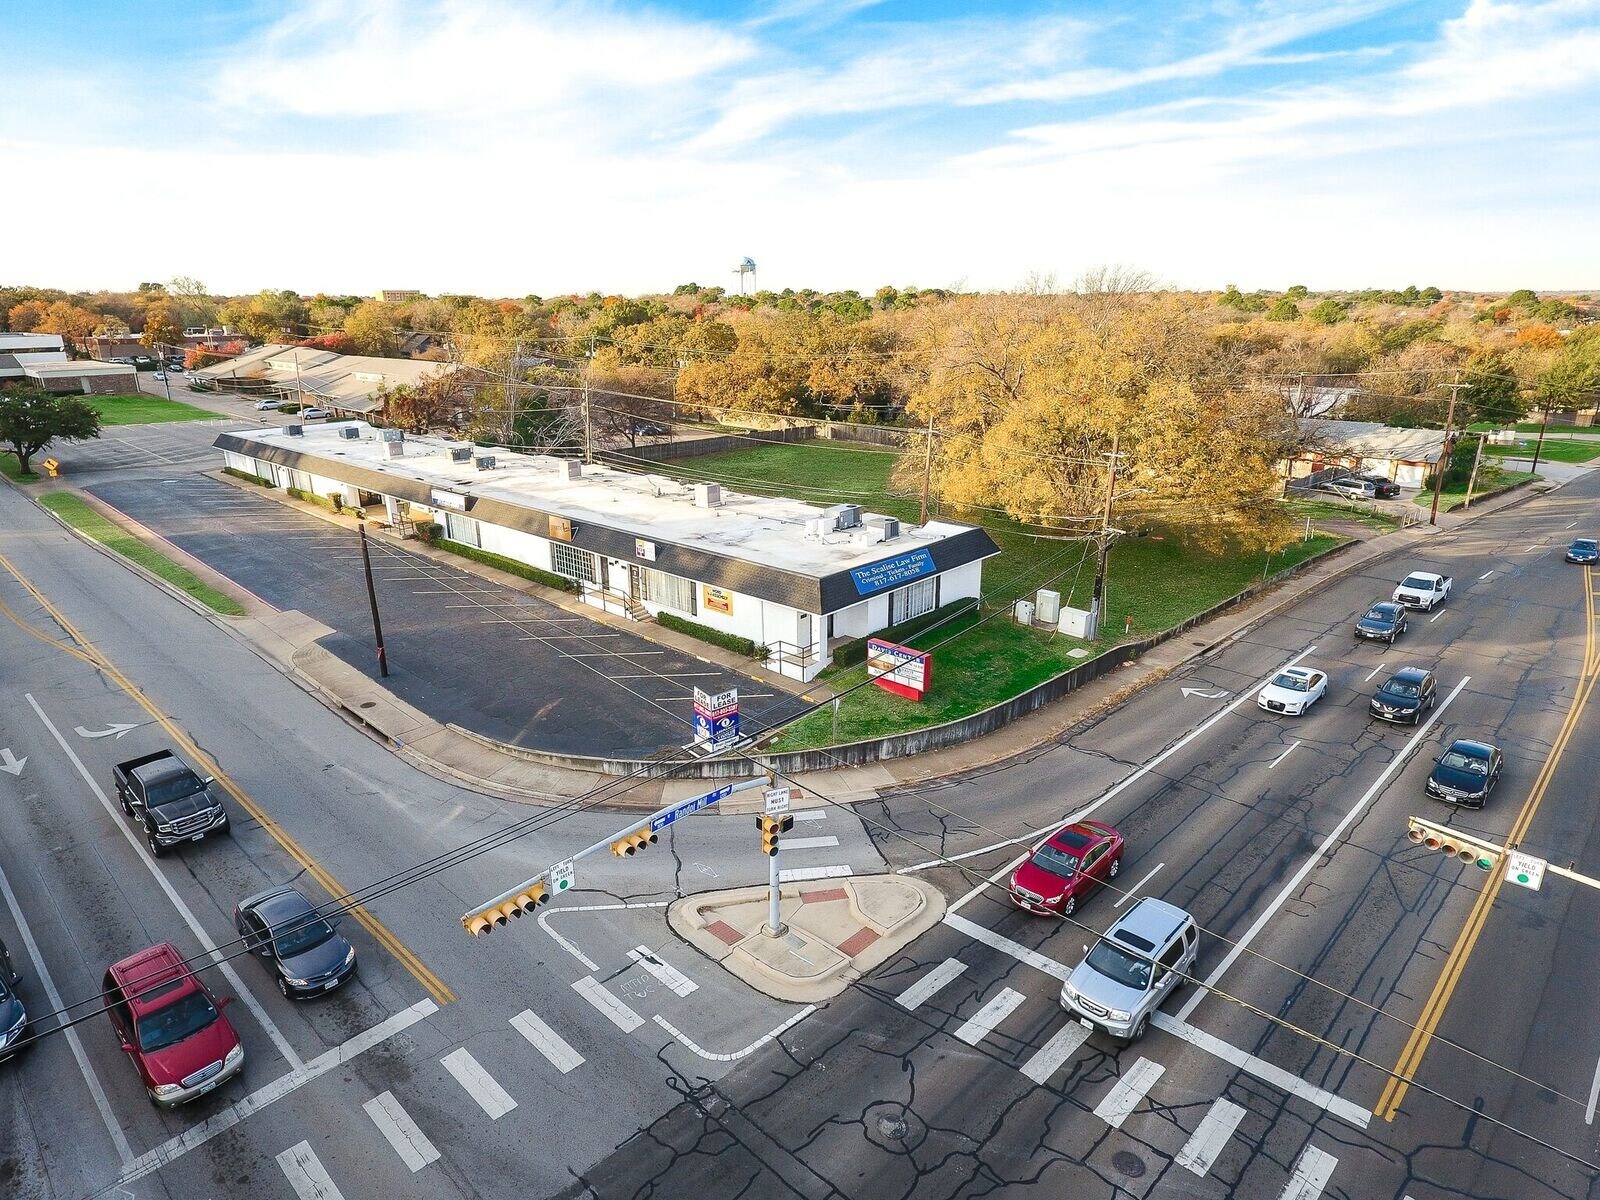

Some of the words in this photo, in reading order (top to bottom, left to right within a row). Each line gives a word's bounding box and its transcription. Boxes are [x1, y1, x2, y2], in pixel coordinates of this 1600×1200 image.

[871, 563, 895, 575] Scalise
[896, 559, 910, 567] Law
[911, 553, 927, 562] Firm
[894, 651, 921, 663] CENTR
[717, 692, 732, 702] FOR
[713, 697, 736, 710] LEASE
[556, 866, 569, 876] YIELD
[1518, 861, 1536, 871] YIELD
